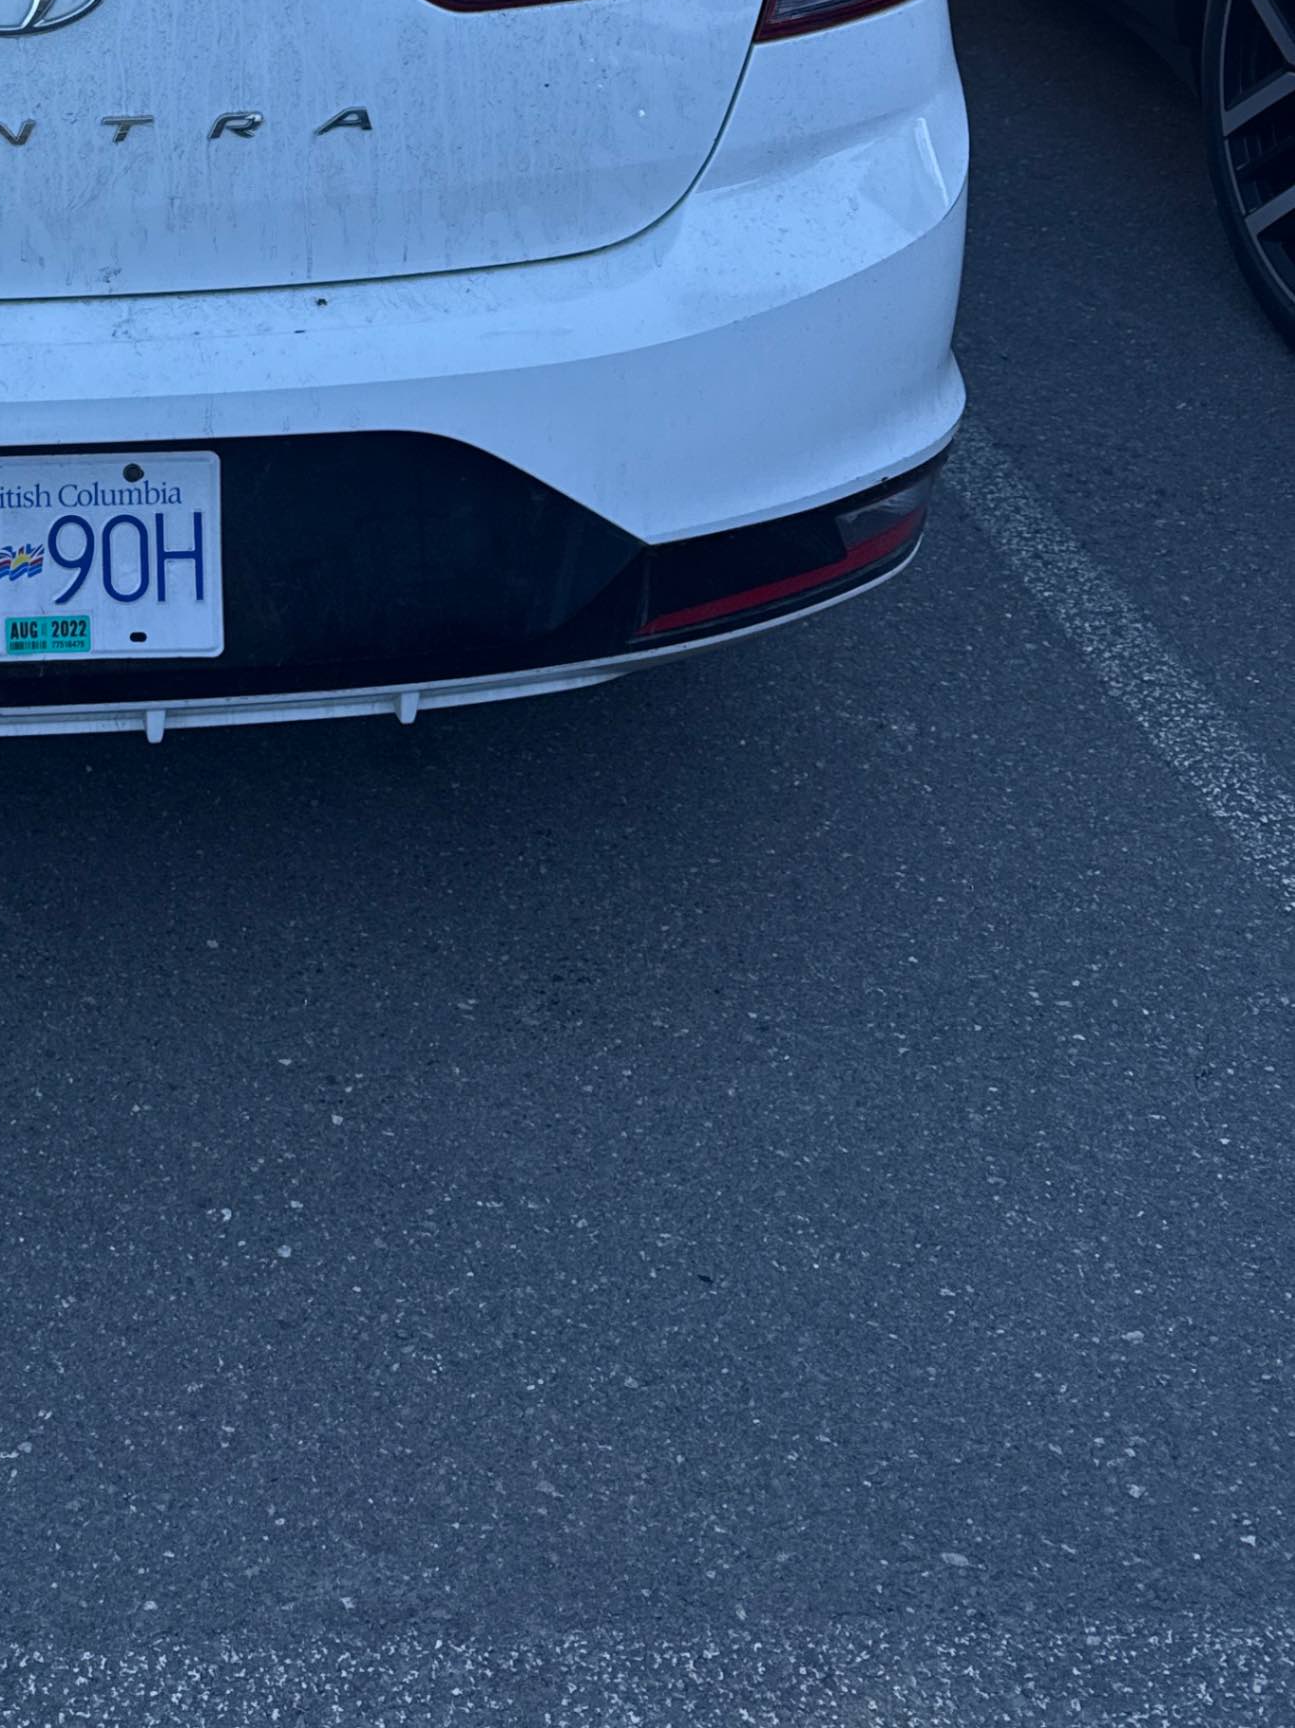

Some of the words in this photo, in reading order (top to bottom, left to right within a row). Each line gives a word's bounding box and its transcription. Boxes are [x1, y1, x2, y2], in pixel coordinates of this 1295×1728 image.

[57, 479, 183, 508] Columbia
[10, 621, 39, 640] AUG
[50, 619, 88, 638] 2022
